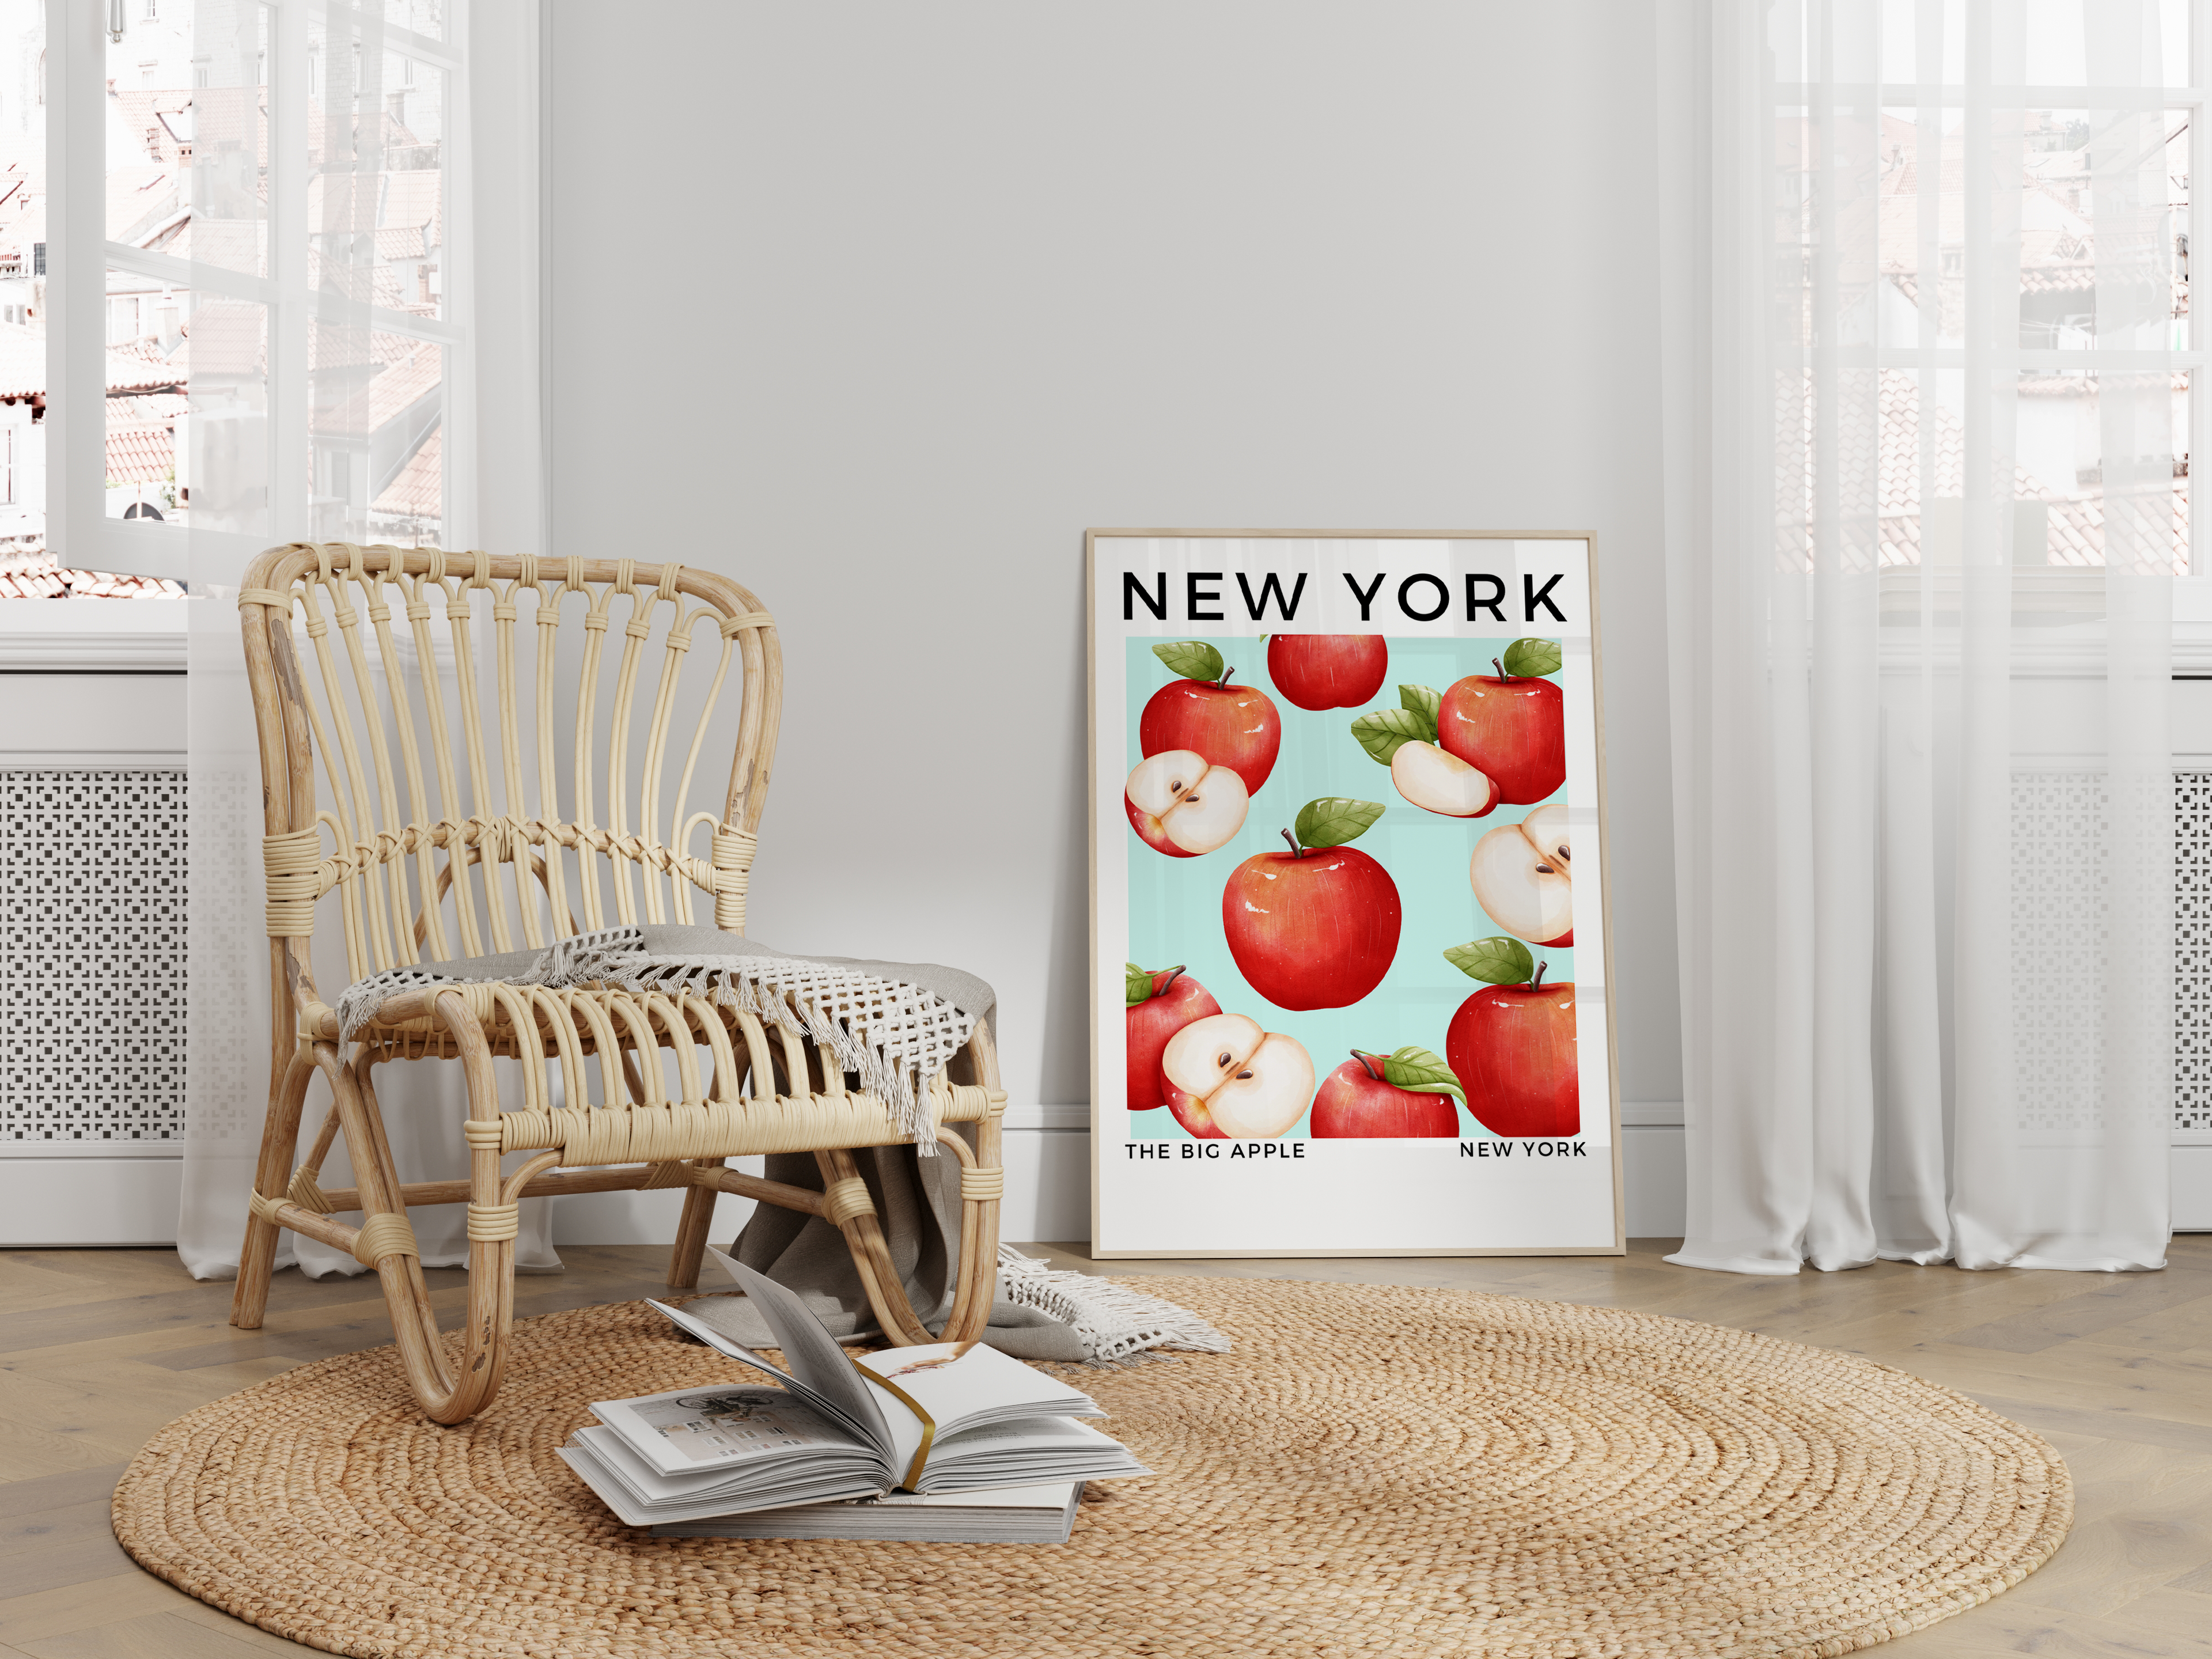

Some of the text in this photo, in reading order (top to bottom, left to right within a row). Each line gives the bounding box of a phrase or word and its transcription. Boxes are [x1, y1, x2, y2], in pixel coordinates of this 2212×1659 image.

[1123, 571, 1567, 623] NEW YORK
[1124, 1142, 1305, 1160] THE BIG APPLE
[1460, 1141, 1587, 1158] NEW YORK
